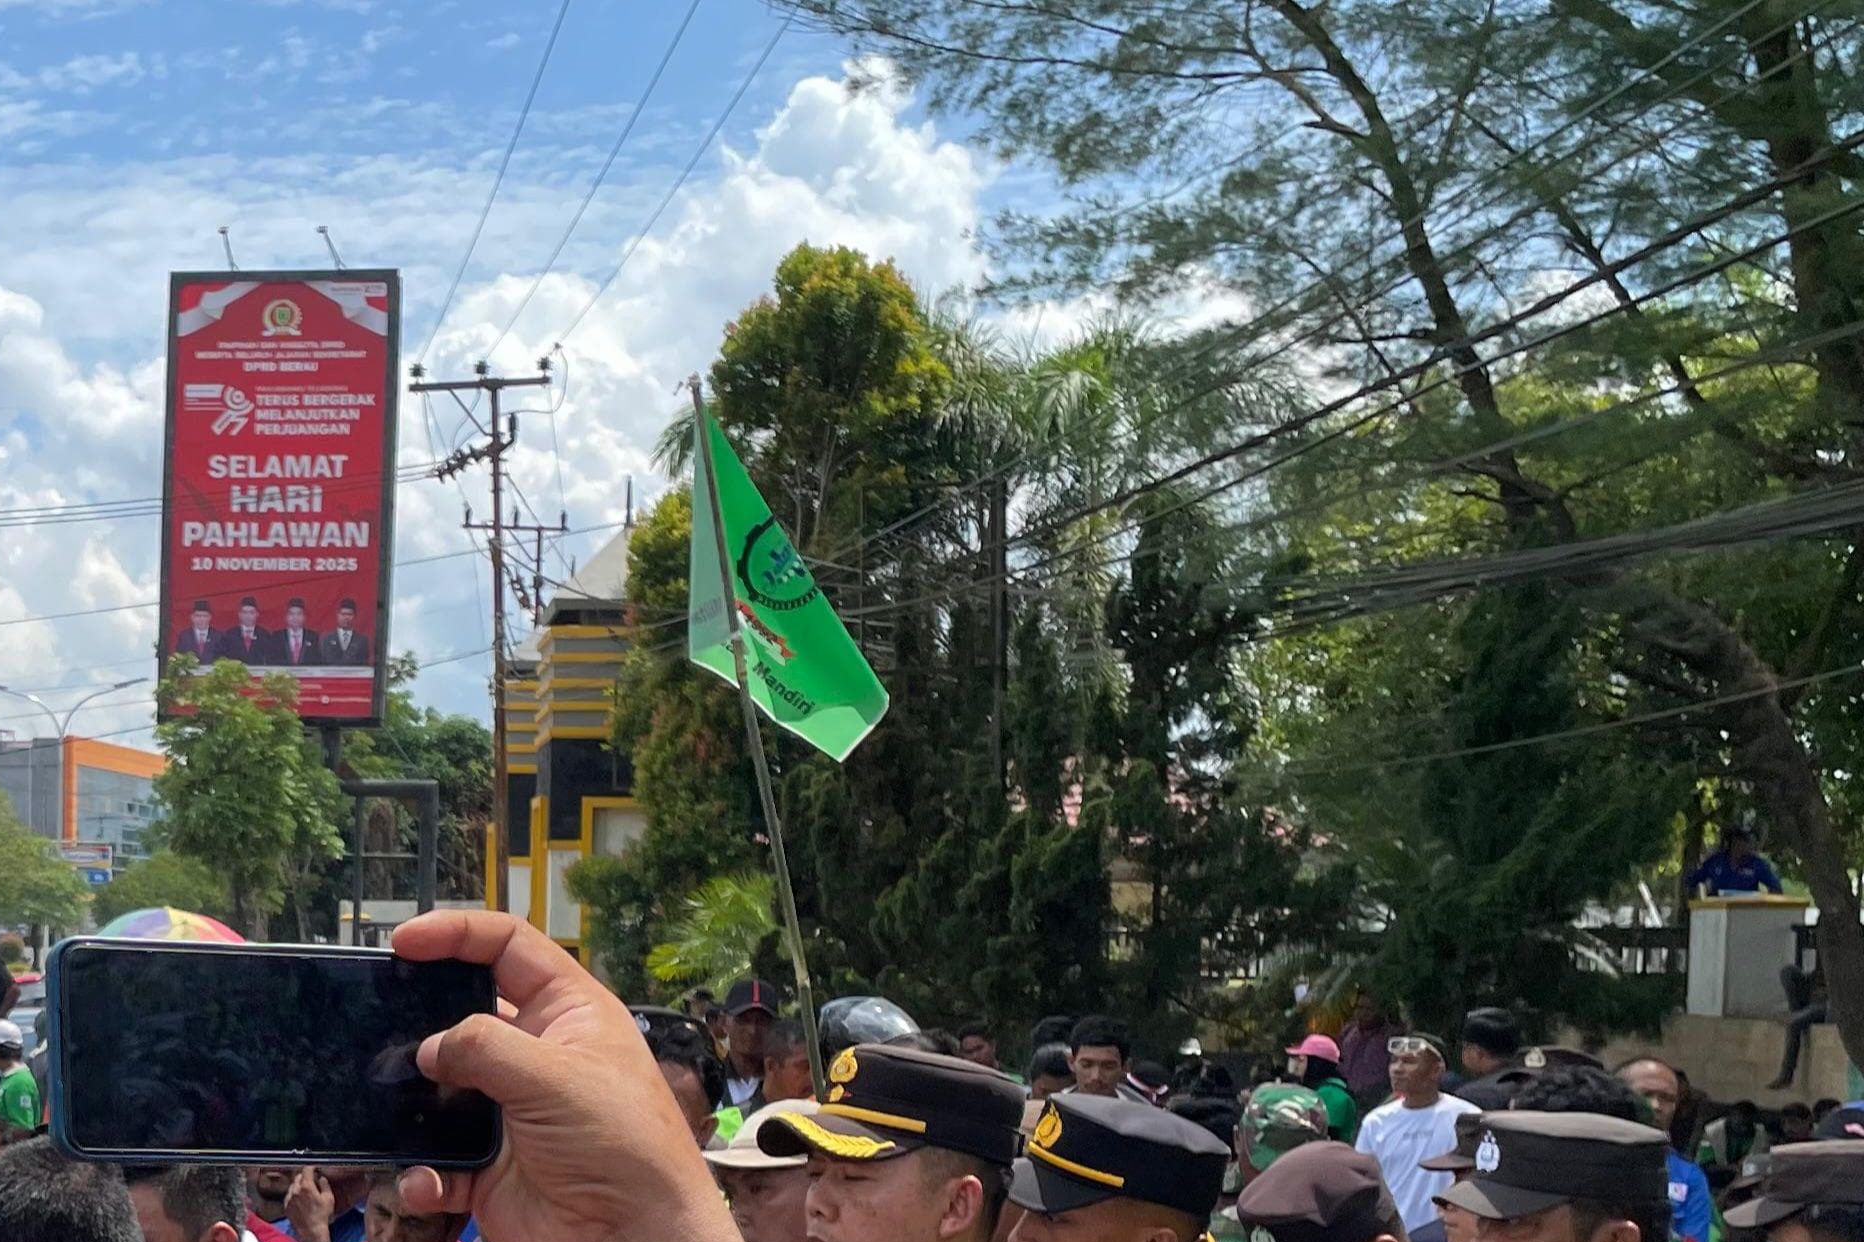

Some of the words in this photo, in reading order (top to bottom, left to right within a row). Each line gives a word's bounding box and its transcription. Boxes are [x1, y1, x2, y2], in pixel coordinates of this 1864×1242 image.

[255, 394, 300, 406] TERUS
[303, 394, 376, 406] BERGERAK
[254, 408, 360, 421] MELANJUTKAN
[254, 423, 351, 435] PERJUANGAN
[207, 454, 349, 479] SELAMAT
[229, 485, 323, 513] HARI
[182, 520, 370, 548] PAHLAWAN
[190, 557, 213, 571] 10
[215, 557, 311, 571] NOVEMBER
[313, 557, 358, 571] 2025
[751, 660, 816, 716] Mandiri
